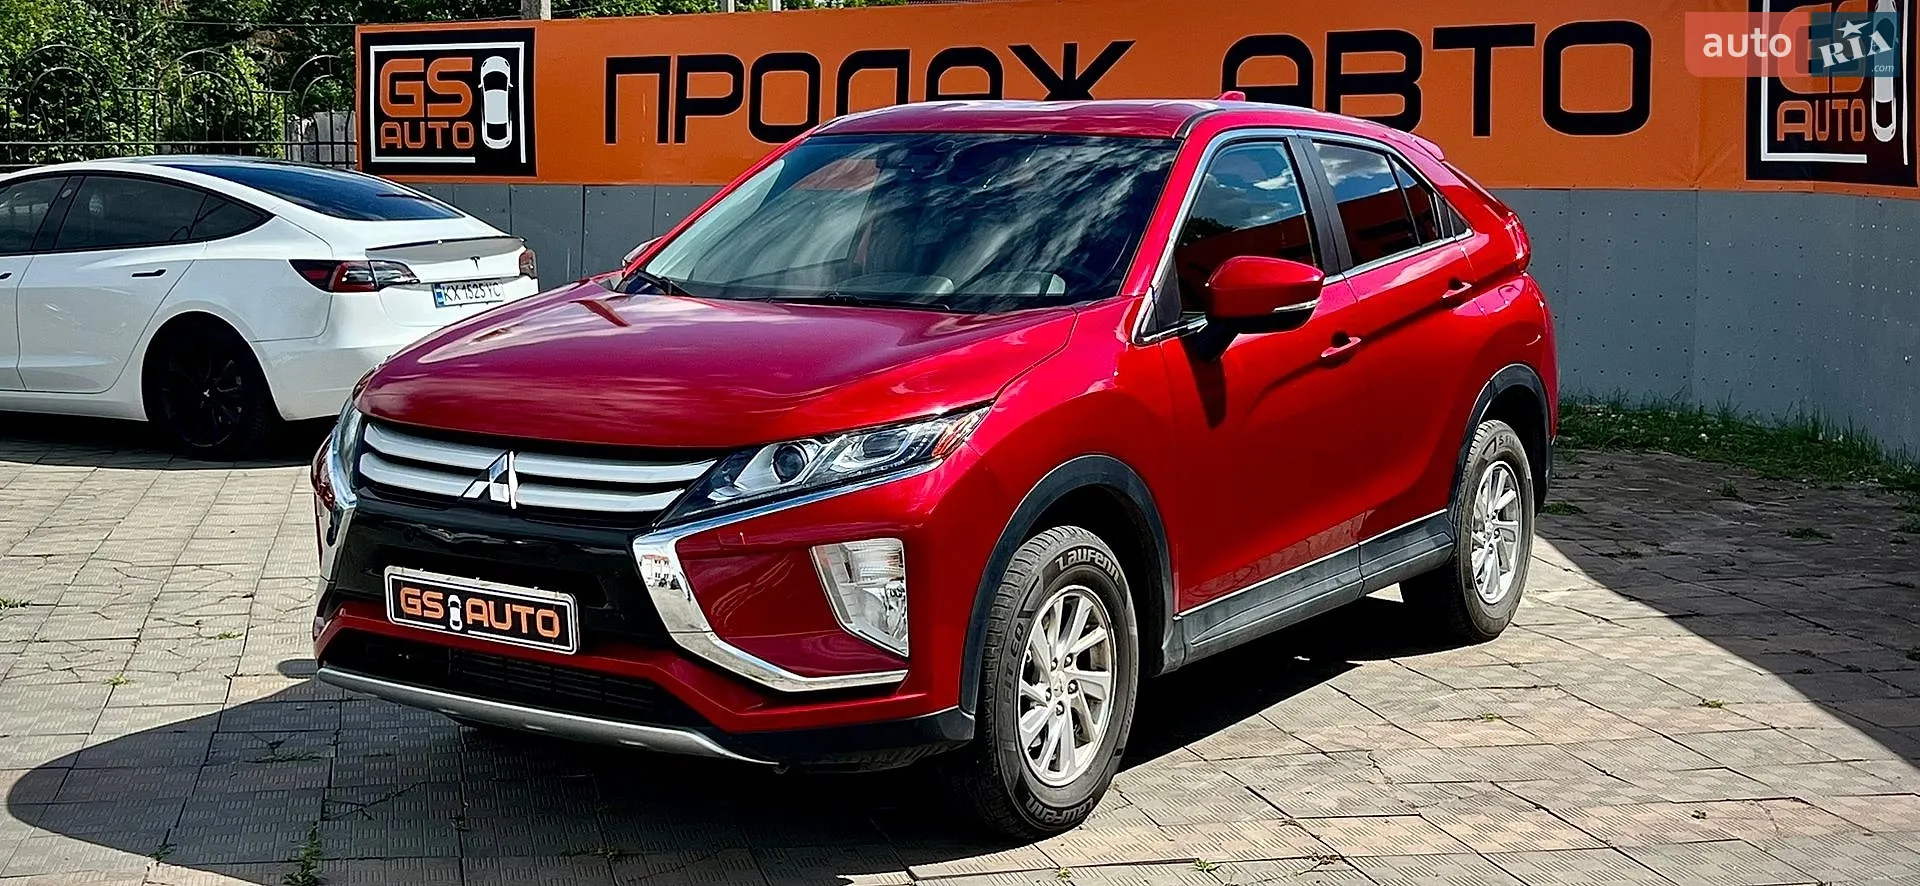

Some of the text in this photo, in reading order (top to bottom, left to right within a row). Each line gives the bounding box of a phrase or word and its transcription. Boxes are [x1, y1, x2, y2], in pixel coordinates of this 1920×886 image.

[380, 57, 473, 118] GS
[1222, 18, 1653, 138] АВТО
[380, 121, 474, 149] AUTO
[1776, 99, 1866, 141] AUTO
[400, 587, 560, 639] GS AUTO
